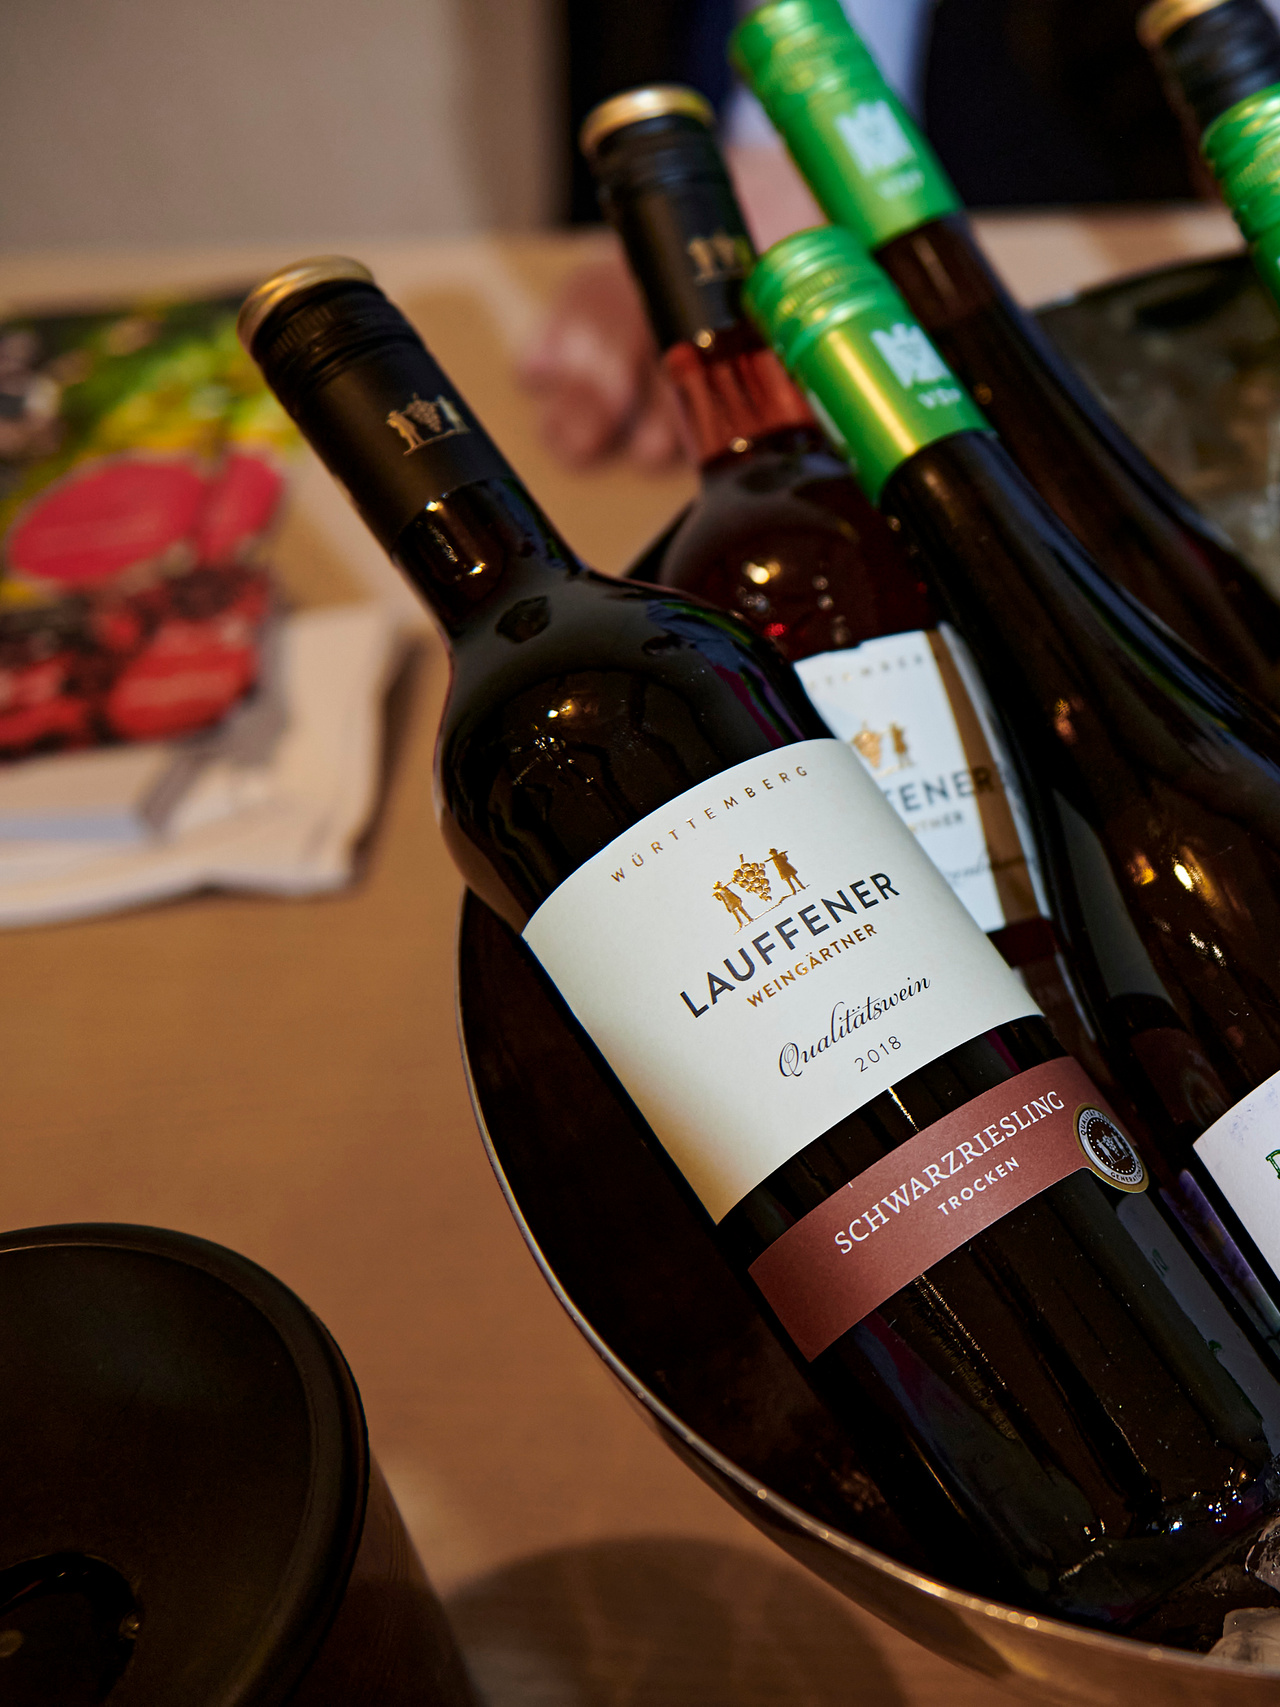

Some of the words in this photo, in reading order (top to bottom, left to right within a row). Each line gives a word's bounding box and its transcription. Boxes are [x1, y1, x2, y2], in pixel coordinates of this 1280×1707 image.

[611, 766, 808, 883] WÜRTTEMBERG
[886, 765, 996, 812] ENER
[680, 872, 900, 1018] LAUFFENER
[746, 923, 878, 1008] WEINGÄRTNER
[779, 975, 931, 1077] Qualitätswein
[854, 1035, 902, 1073] 2018
[834, 1091, 1065, 1255] SCHWARZRIESLING
[938, 1156, 1020, 1216] TROCKEN
